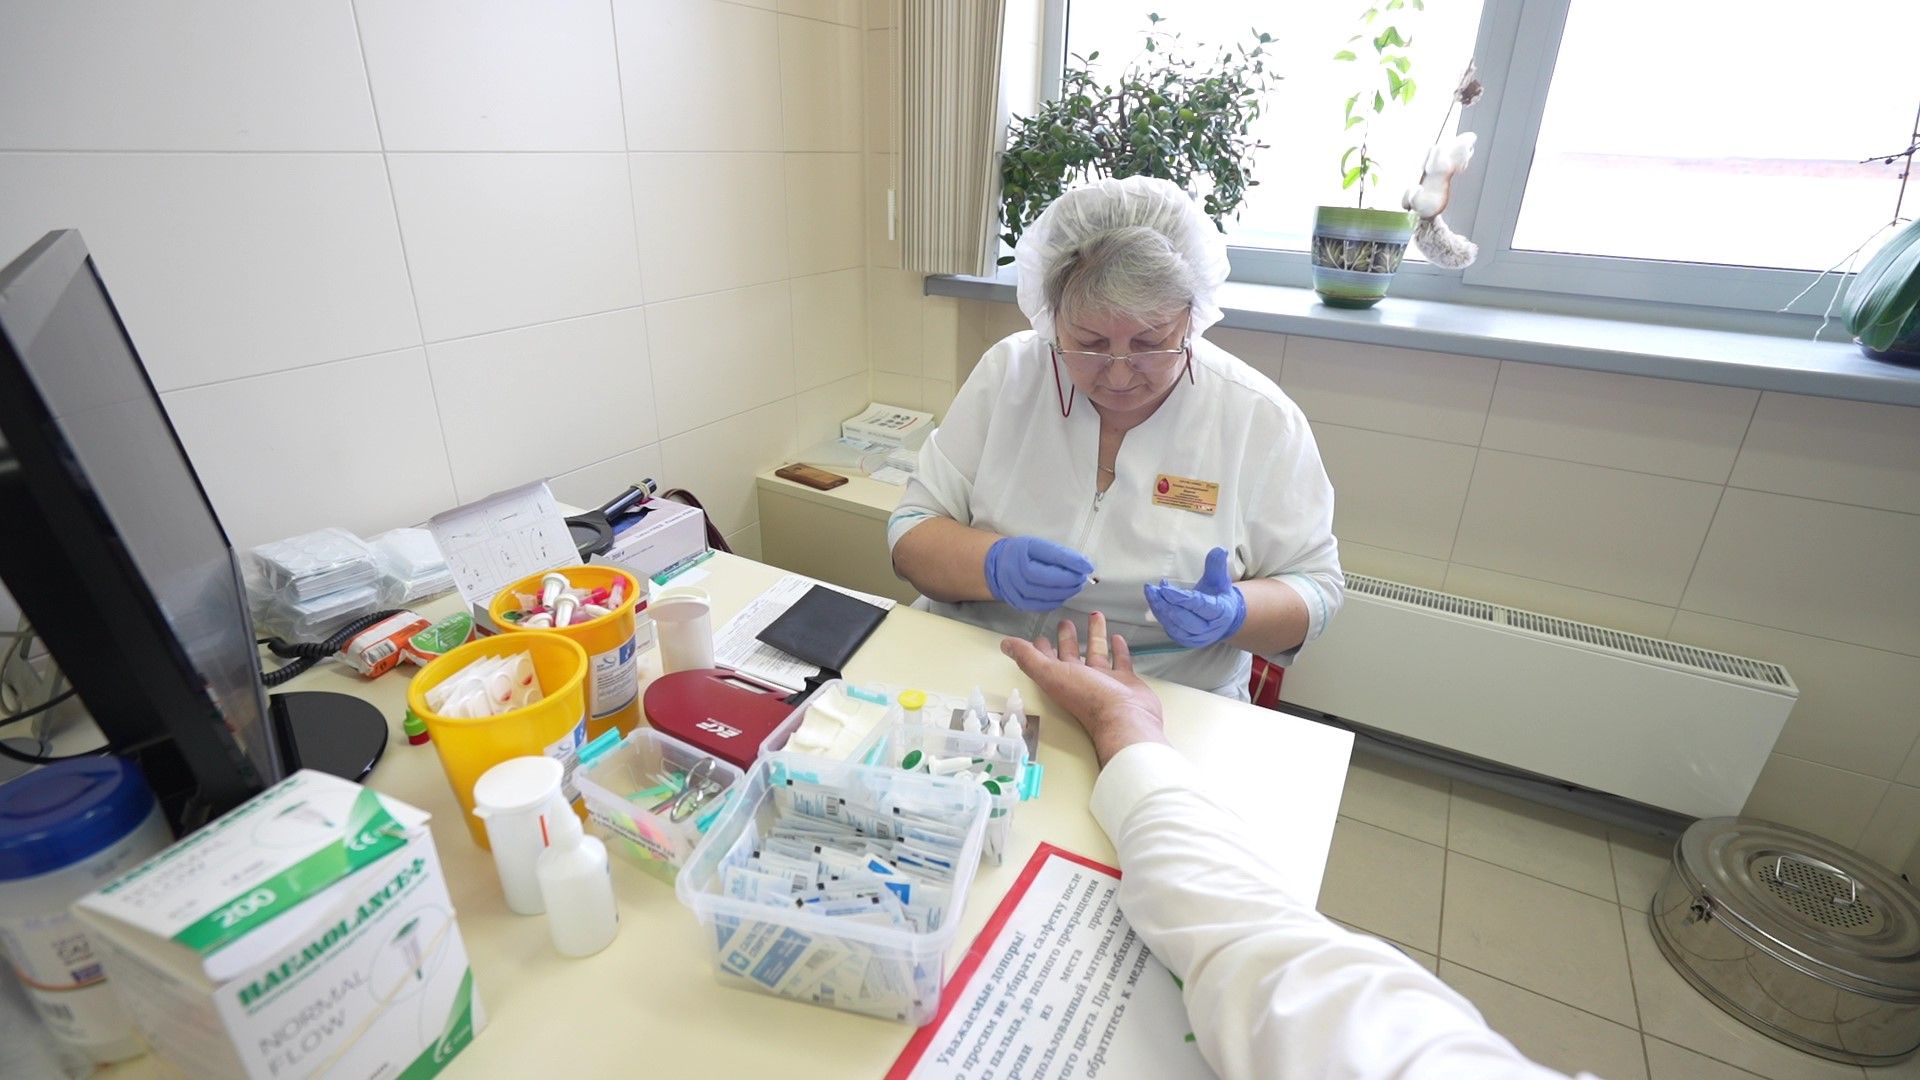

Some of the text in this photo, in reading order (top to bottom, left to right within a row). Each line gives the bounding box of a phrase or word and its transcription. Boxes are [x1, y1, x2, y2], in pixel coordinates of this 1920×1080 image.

[212, 887, 277, 929] 200
[962, 1019, 997, 1071] просим
[994, 1001, 1007, 1017] не
[1004, 952, 1037, 999] убирать
[1033, 901, 1067, 949] салфетку
[1061, 873, 1082, 901] после
[990, 1017, 1025, 1067] пальца,
[1020, 997, 1033, 1014] до
[1029, 948, 1060, 996] полного
[1056, 879, 1099, 947] прекращения
[1040, 1005, 1053, 1020] из
[1060, 949, 1083, 982] места
[1083, 928, 1115, 982] материал
[258, 972, 368, 1055] NORMAL
[936, 931, 1026, 1064] Уважаемые доноры!
[1073, 1012, 1098, 1051] цвета.
[1091, 981, 1112, 1007] При
[1086, 1004, 1125, 1078] обратитесь
[1121, 989, 1131, 1001] к
[267, 1009, 347, 1077] FLOW
